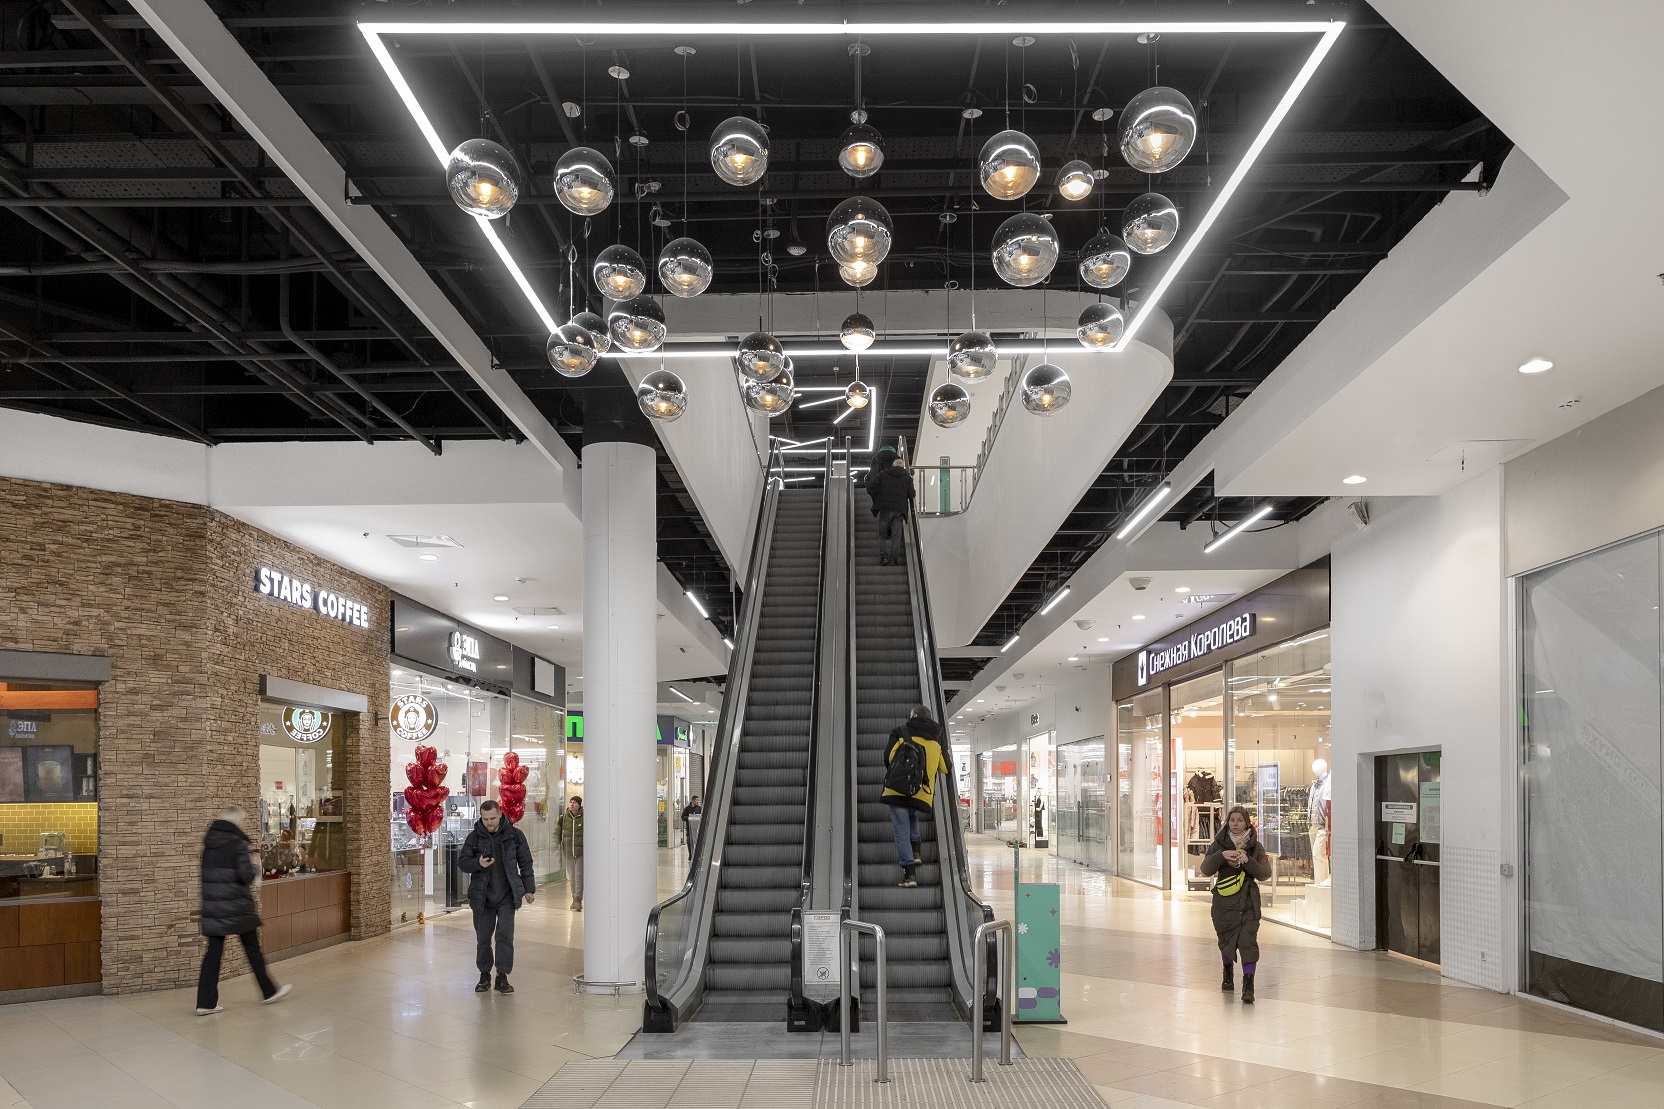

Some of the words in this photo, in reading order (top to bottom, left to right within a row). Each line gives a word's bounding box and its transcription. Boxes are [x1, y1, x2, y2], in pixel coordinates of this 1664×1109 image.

[258, 567, 312, 610] STARS
[318, 590, 369, 629] COFFEE
[1149, 640, 1189, 675] Снежная
[1190, 612, 1250, 659] Королева
[396, 694, 428, 709] STARS
[396, 726, 428, 741] COFFEE
